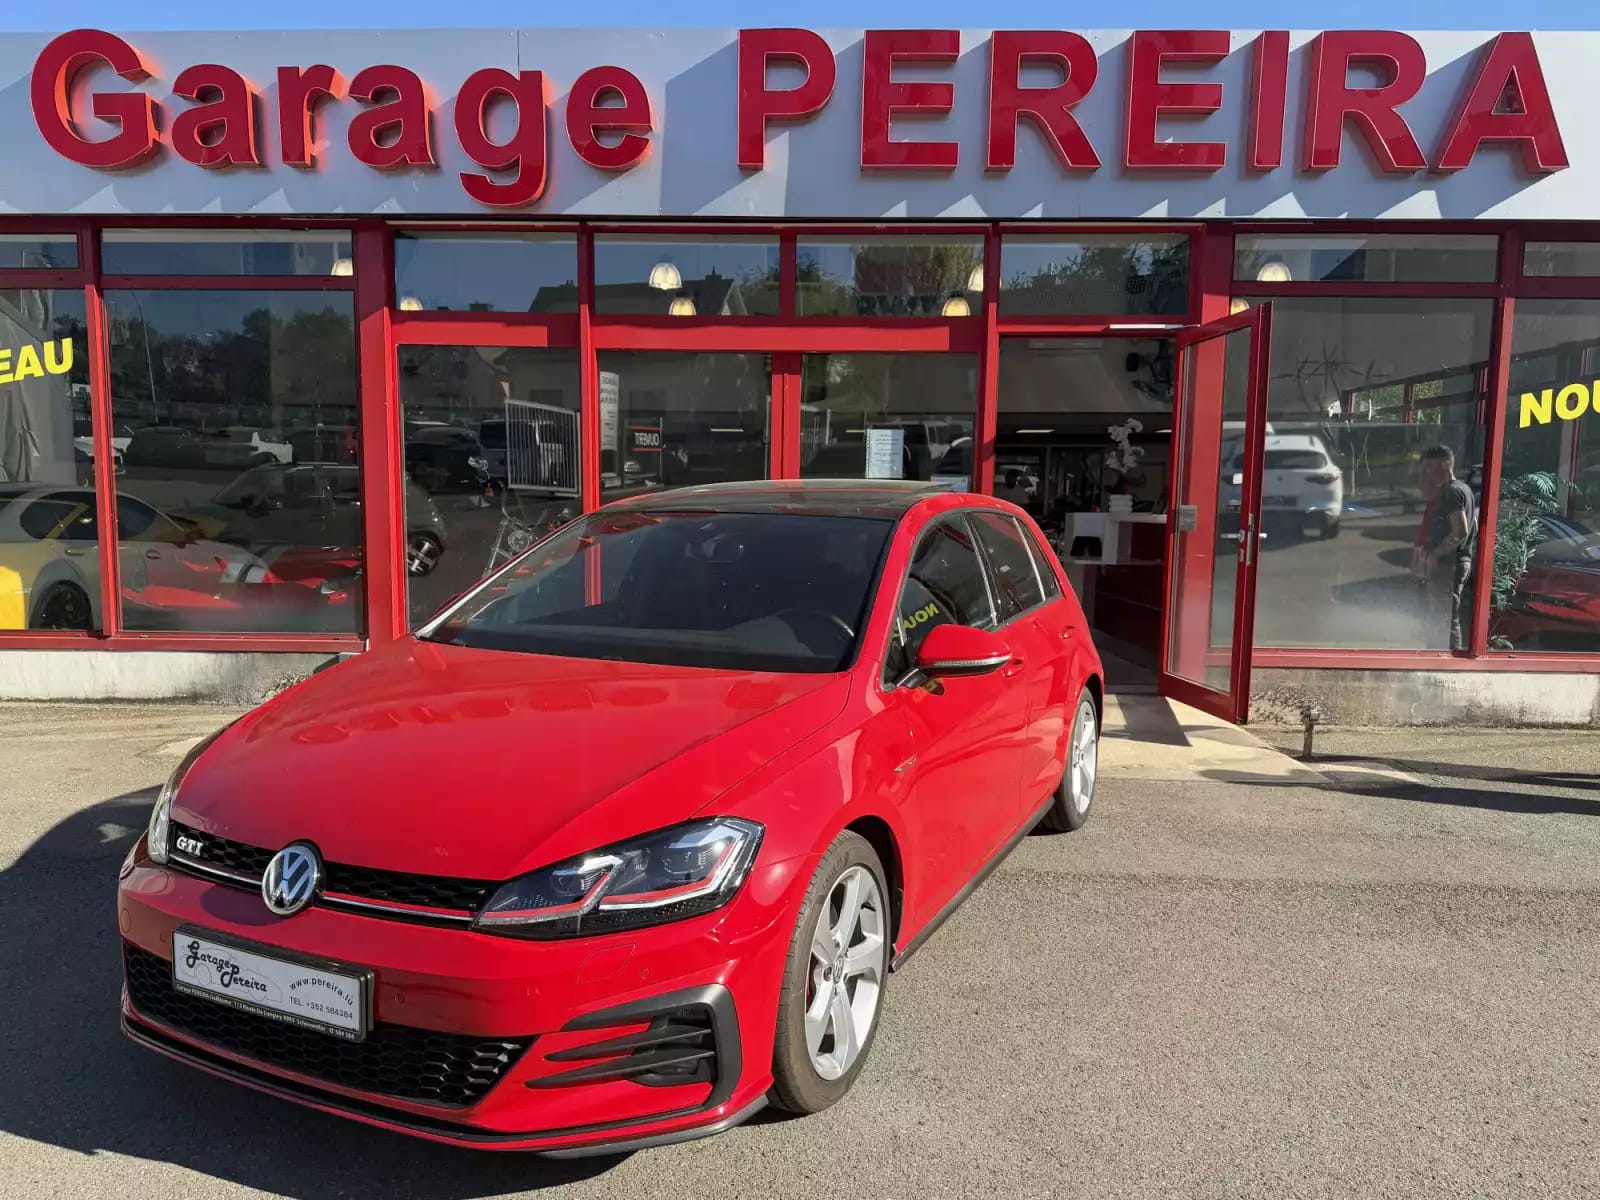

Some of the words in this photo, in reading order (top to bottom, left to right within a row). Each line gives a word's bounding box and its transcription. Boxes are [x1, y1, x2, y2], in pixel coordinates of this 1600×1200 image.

[30, 29, 653, 207] Garage
[736, 28, 1571, 173] PEREIRA
[176, 836, 204, 856] GTI
[186, 940, 232, 973] Garage
[220, 963, 268, 992] Pereira
[289, 977, 354, 1006] www.pereira.lu
